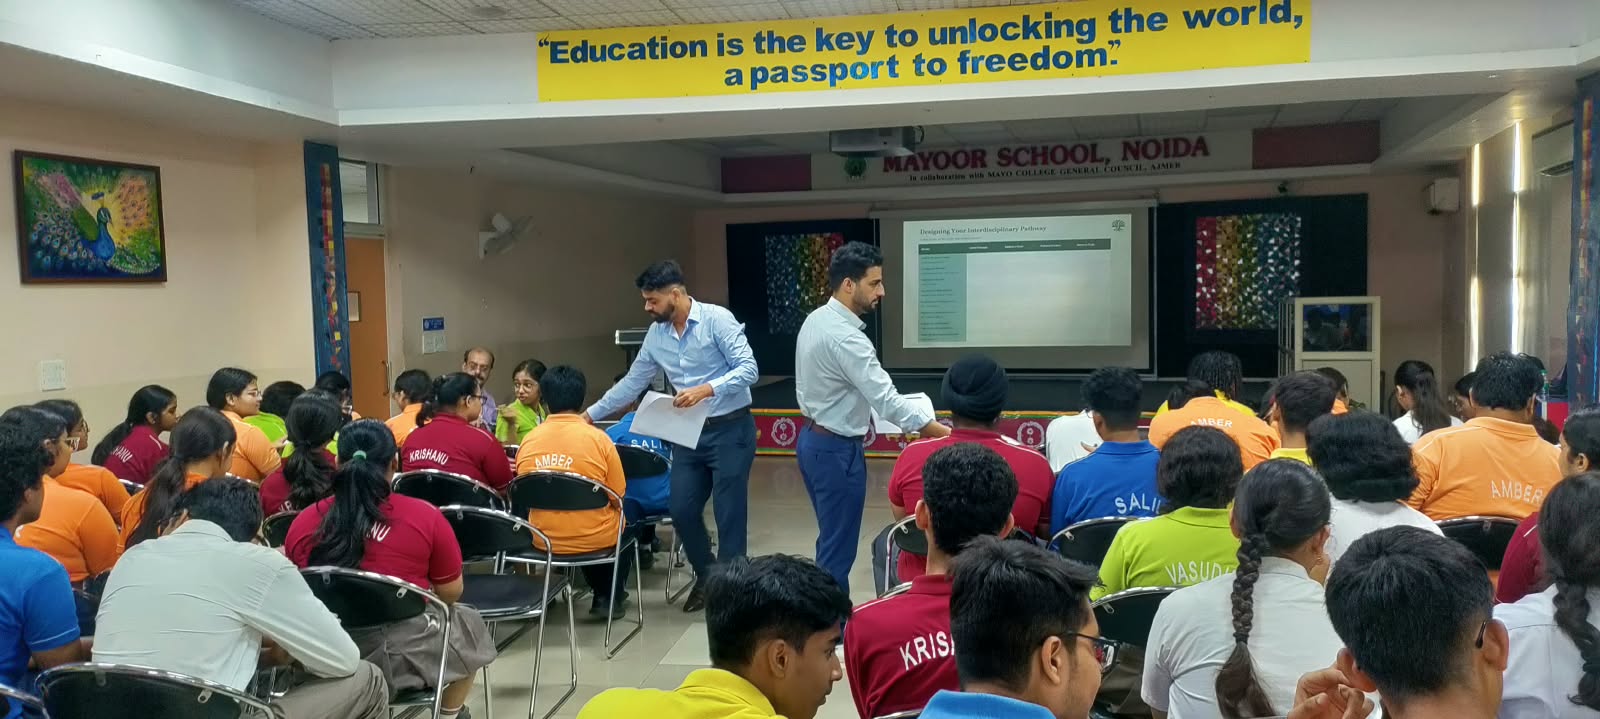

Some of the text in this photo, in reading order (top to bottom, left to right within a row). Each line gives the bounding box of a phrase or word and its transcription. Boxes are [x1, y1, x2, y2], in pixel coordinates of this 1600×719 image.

[717, 32, 744, 57] is
[753, 30, 806, 55] the
[815, 27, 875, 56] key
[885, 24, 918, 48] to
[928, 12, 1096, 46] unlocking
[1108, 7, 1168, 33] the
[1183, 0, 1303, 30] world,
[724, 66, 743, 86] a
[750, 56, 899, 90] passport
[912, 52, 946, 76] to
[883, 135, 1210, 173] MAYOOR SCHOOL, NOIDA
[969, 171, 985, 179] with
[988, 170, 1012, 178] MAYO
[1015, 168, 1056, 177] COLLEGE
[1060, 166, 1100, 175] GENERAL
[1151, 161, 1181, 170] AJMER
[920, 225, 1047, 236] Designing Your Interdisciplinary Pathway
[409, 447, 449, 465] KRISHANU
[534, 453, 573, 470] AMBER
[1490, 479, 1544, 504] AMBER
[1165, 560, 1230, 585] VASUD
